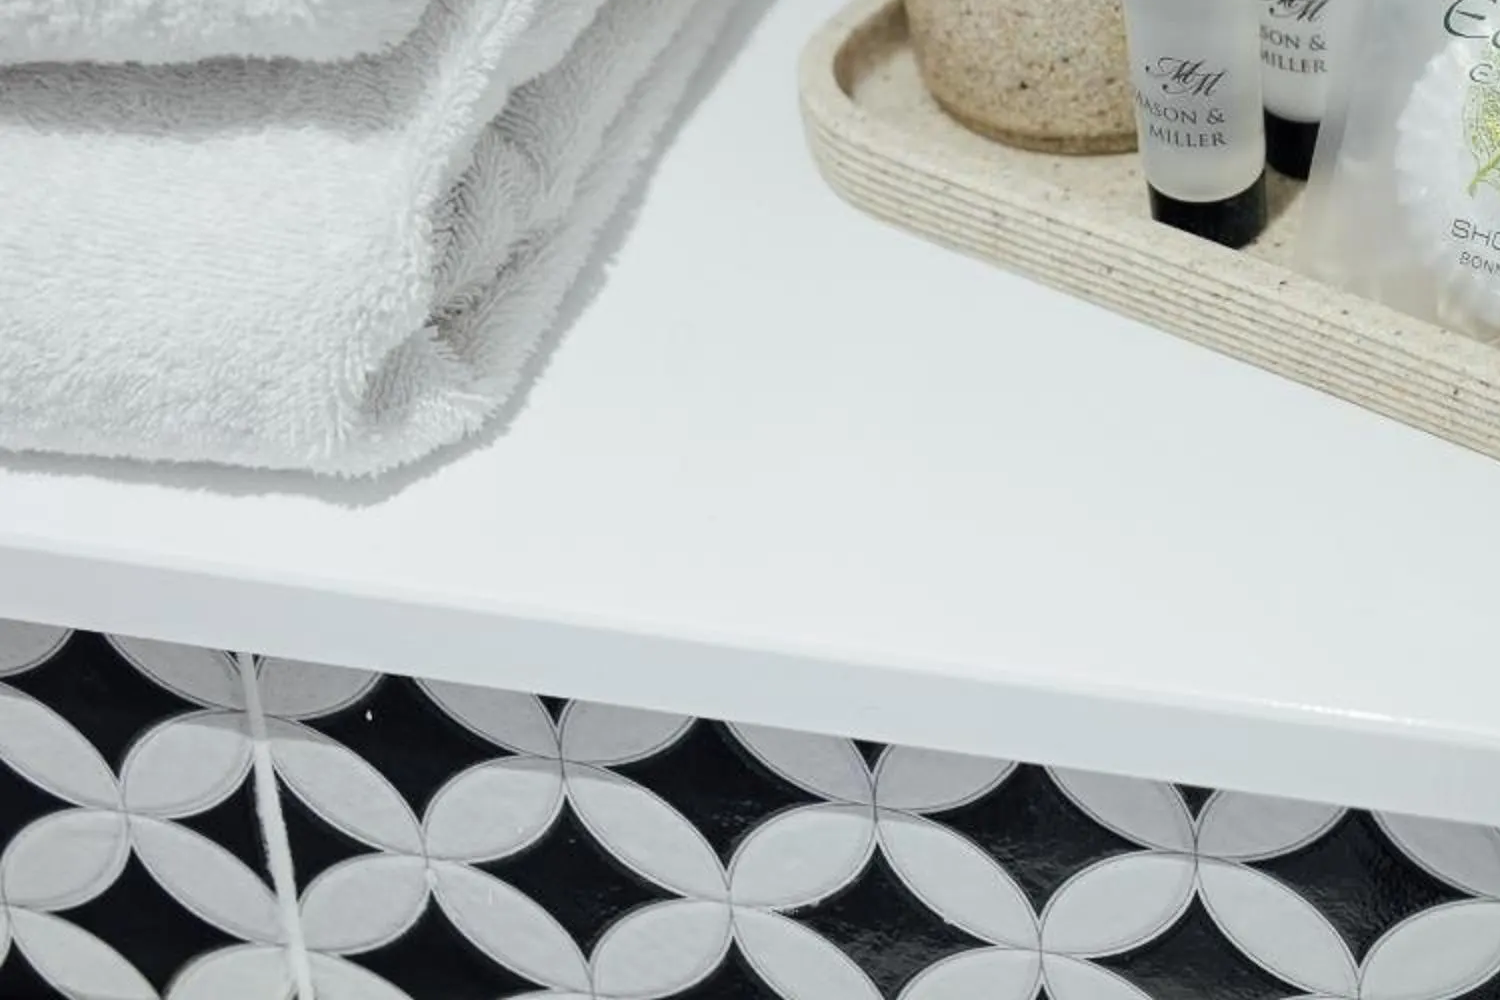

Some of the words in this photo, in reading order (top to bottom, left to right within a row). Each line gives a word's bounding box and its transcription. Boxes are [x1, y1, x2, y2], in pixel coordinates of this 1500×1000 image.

[1260, 23, 1301, 51] SON
[1309, 33, 1328, 52] &
[1206, 107, 1226, 126] &
[1149, 125, 1228, 148] MILLER
